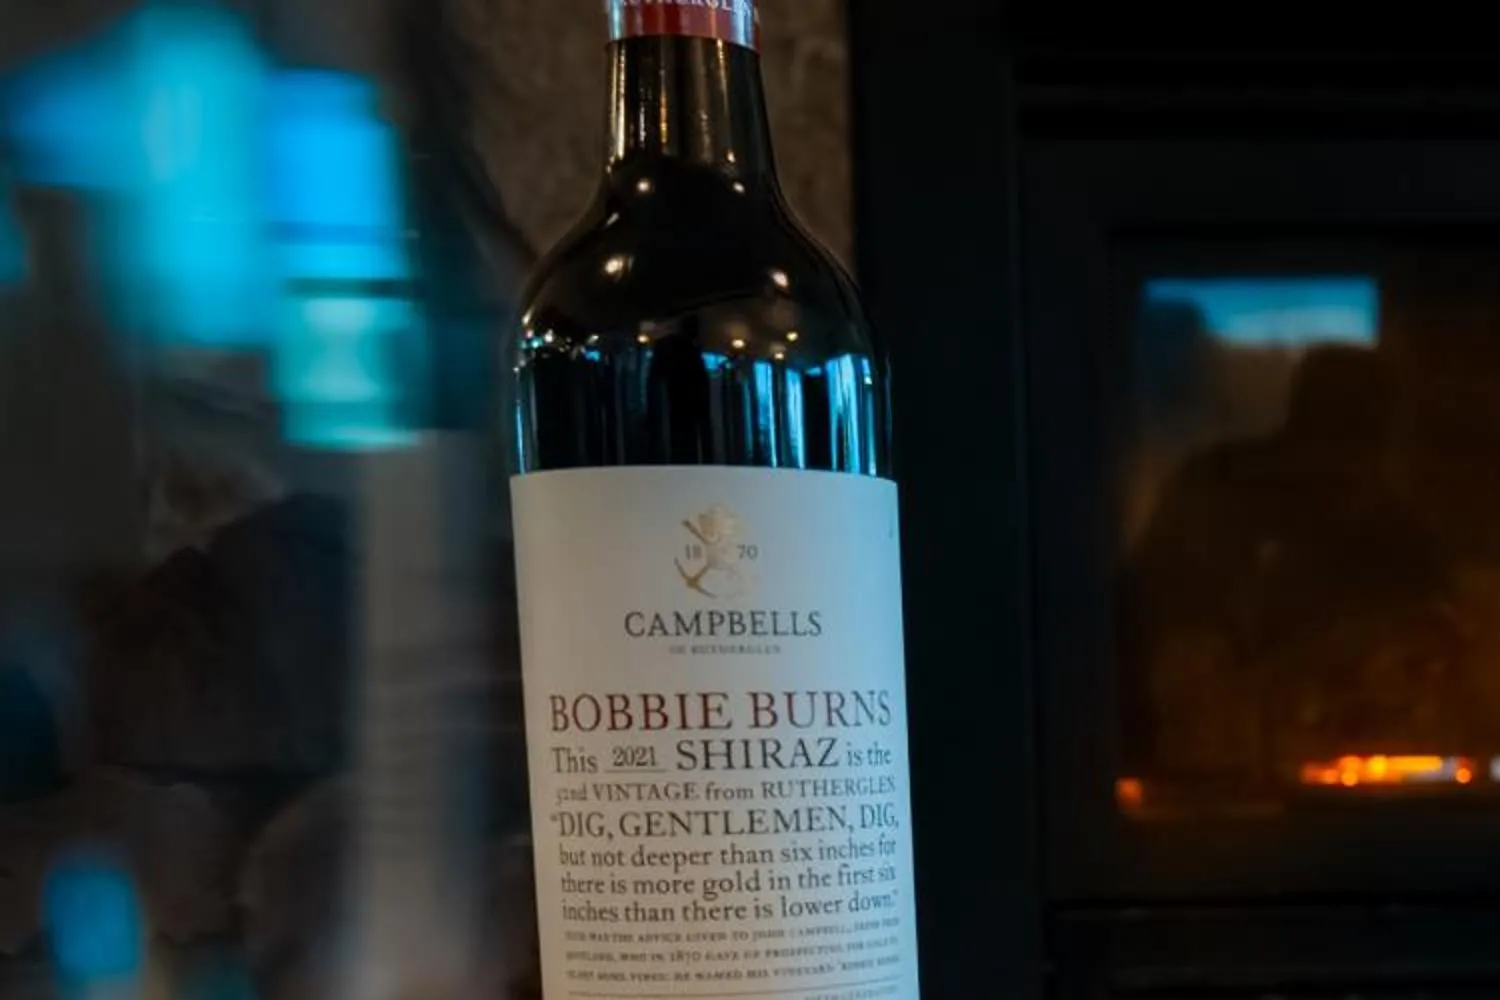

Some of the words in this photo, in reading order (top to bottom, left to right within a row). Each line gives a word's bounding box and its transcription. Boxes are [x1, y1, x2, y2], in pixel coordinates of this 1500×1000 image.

[738, 544, 758, 560] 70
[624, 610, 823, 637] CAMPBELLS
[549, 692, 733, 732] BOBBIE
[746, 690, 892, 729] BURNS
[552, 746, 598, 773] This
[612, 746, 656, 767] 2021
[676, 737, 838, 771] SHIRAZ
[847, 742, 862, 767] is
[867, 741, 891, 766] the
[592, 782, 696, 801] VINTAGE
[706, 781, 754, 800] from
[761, 775, 895, 799] RUTHERGLEN
[619, 806, 854, 838] GENTLEMEN,
[860, 802, 899, 829] DIG,
[559, 842, 585, 866] but
[592, 849, 625, 867] not
[631, 844, 712, 874] deeper
[720, 843, 774, 865] than
[780, 840, 814, 862] six
[818, 837, 875, 860] inches
[878, 832, 897, 856] for
[561, 871, 605, 894] there
[610, 872, 627, 894] is
[633, 879, 695, 895] more
[702, 869, 761, 901] gold
[768, 869, 791, 890] in
[798, 867, 832, 889] the
[837, 863, 874, 887] first
[878, 865, 896, 881] six
[562, 899, 619, 923] inches
[624, 901, 675, 922] than
[682, 899, 747, 922] there
[754, 898, 774, 919] is
[781, 896, 843, 918] lower
